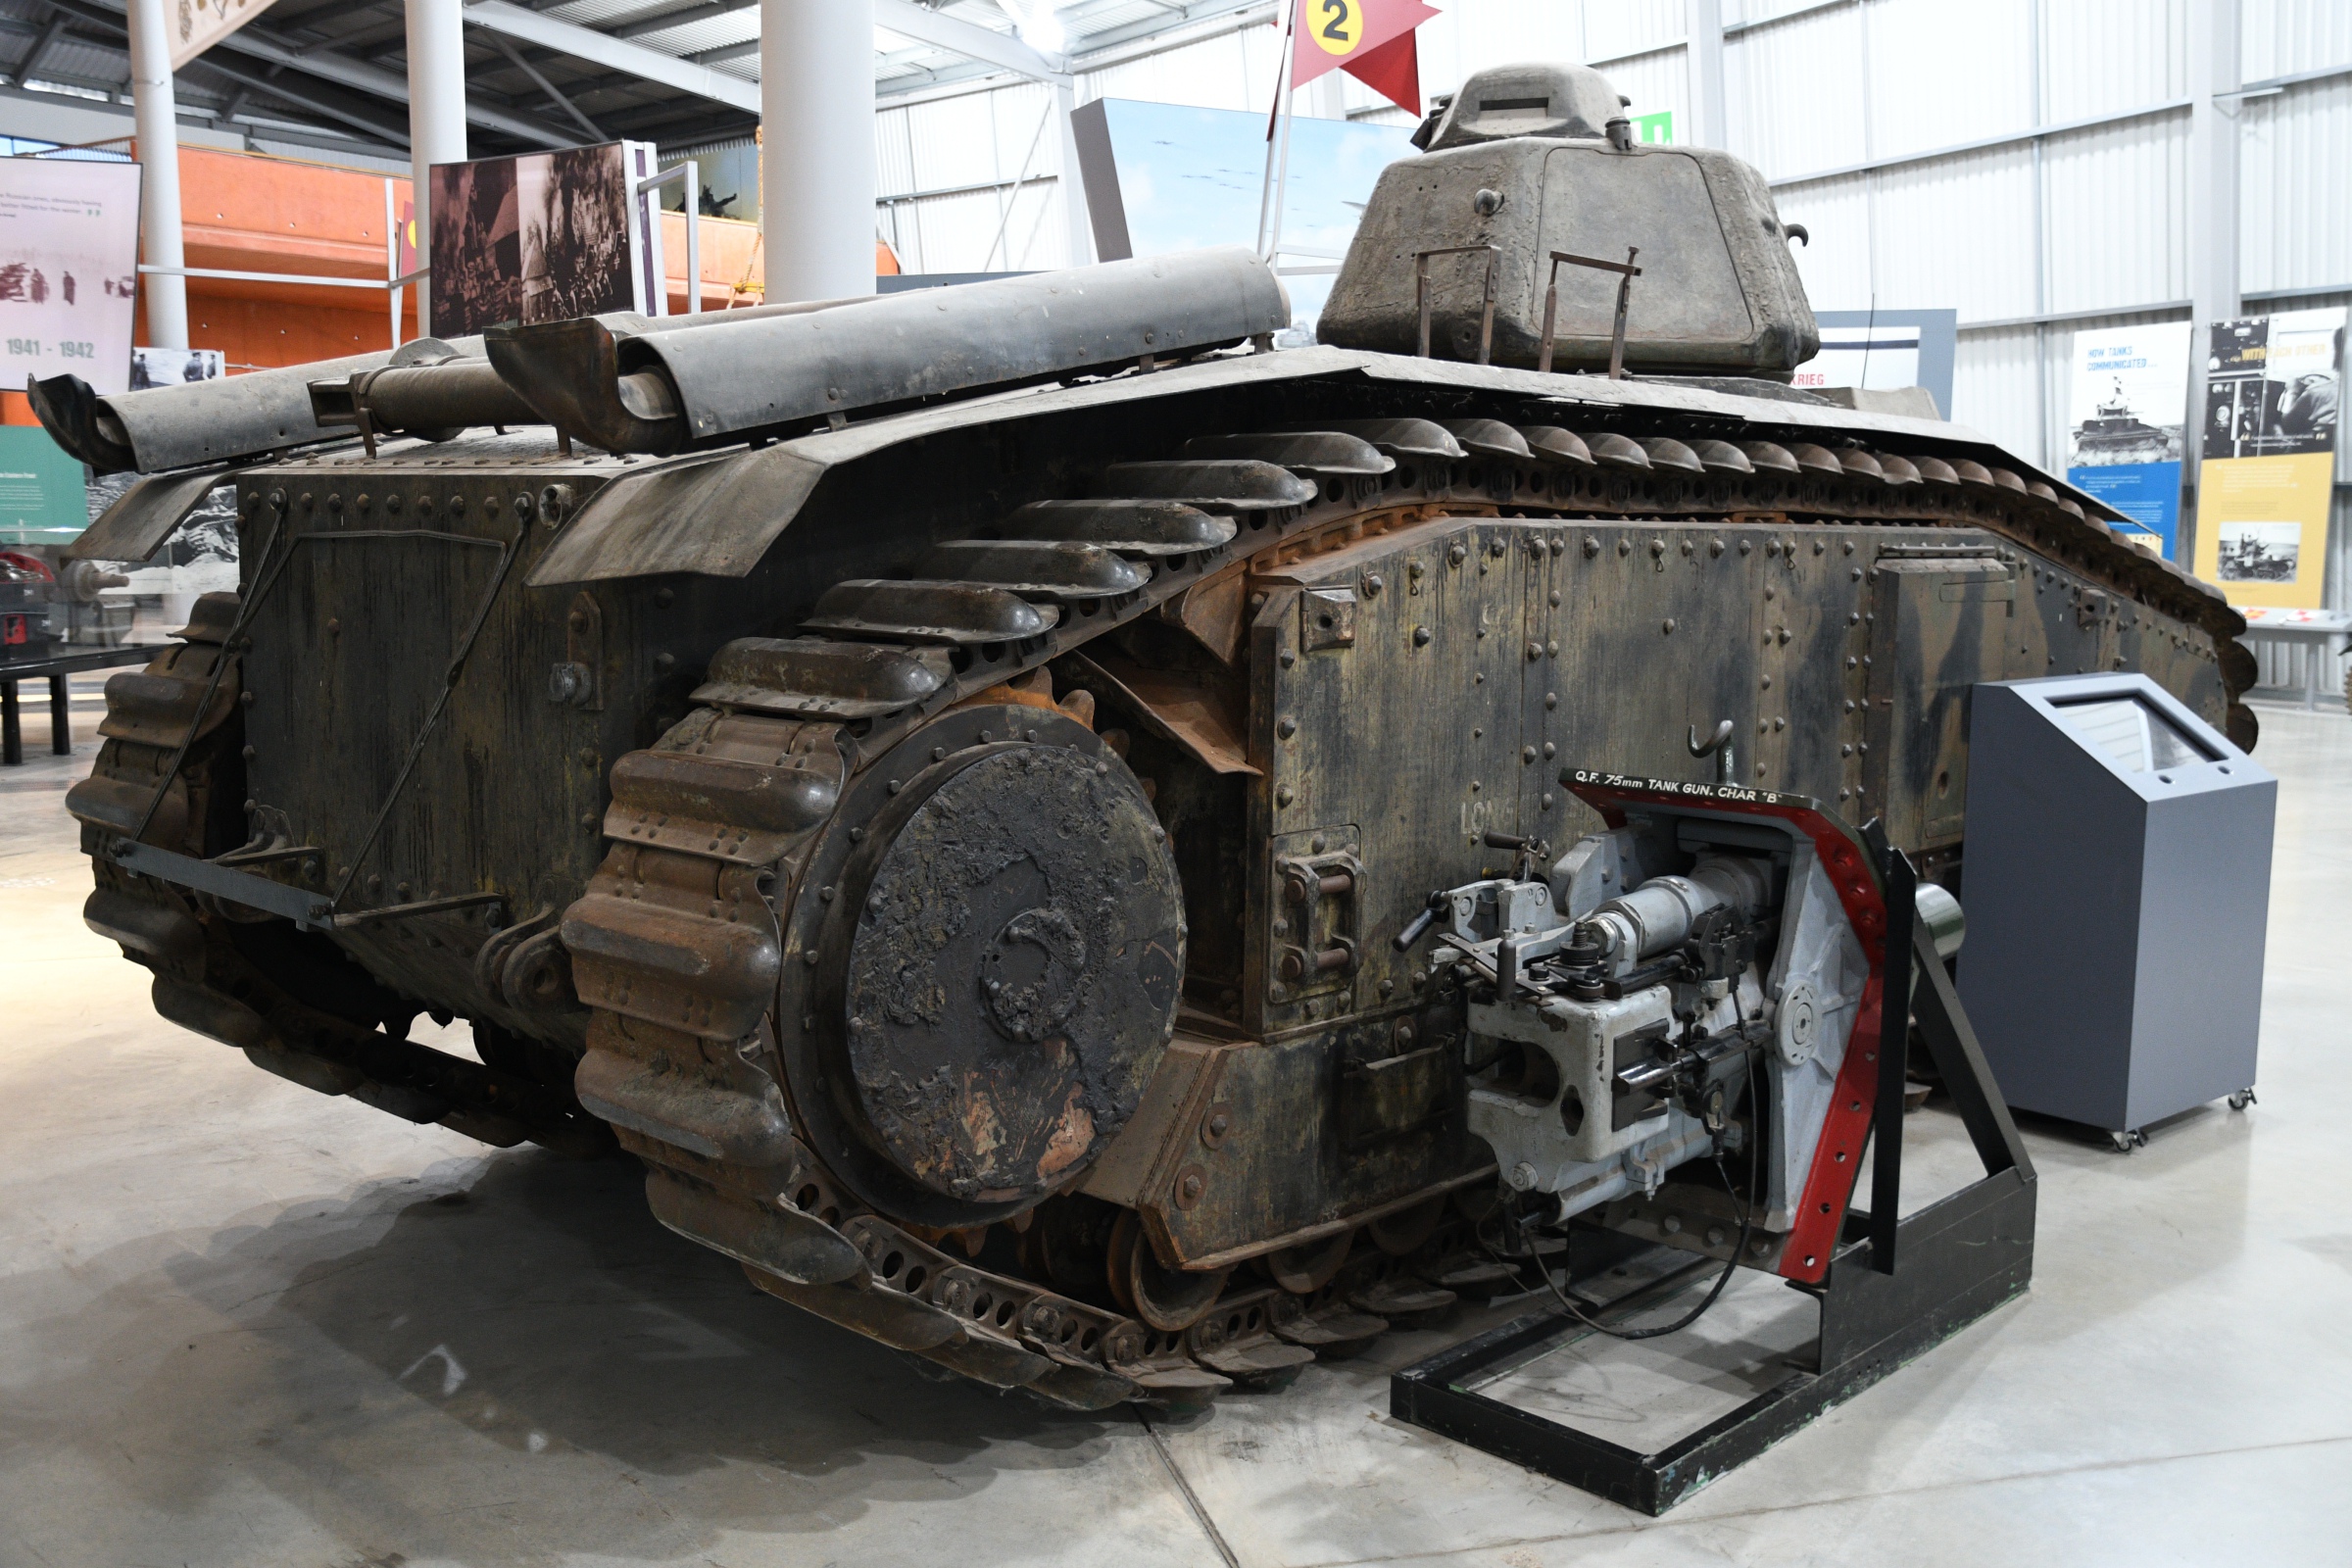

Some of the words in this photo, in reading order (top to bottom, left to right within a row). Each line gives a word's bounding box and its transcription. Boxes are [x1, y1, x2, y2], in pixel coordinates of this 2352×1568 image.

[1323, 0, 1348, 41] 2
[6, 338, 40, 356] 1941
[59, 341, 94, 359] 1942
[2087, 348, 2105, 359] HOW
[2108, 346, 2133, 357] TANKS
[1575, 770, 1599, 783] Q.F.
[1604, 774, 1642, 788] 75mm
[1648, 778, 1679, 793] TANK
[1682, 783, 1714, 797] GUN.
[1718, 787, 1756, 802] CHAR
